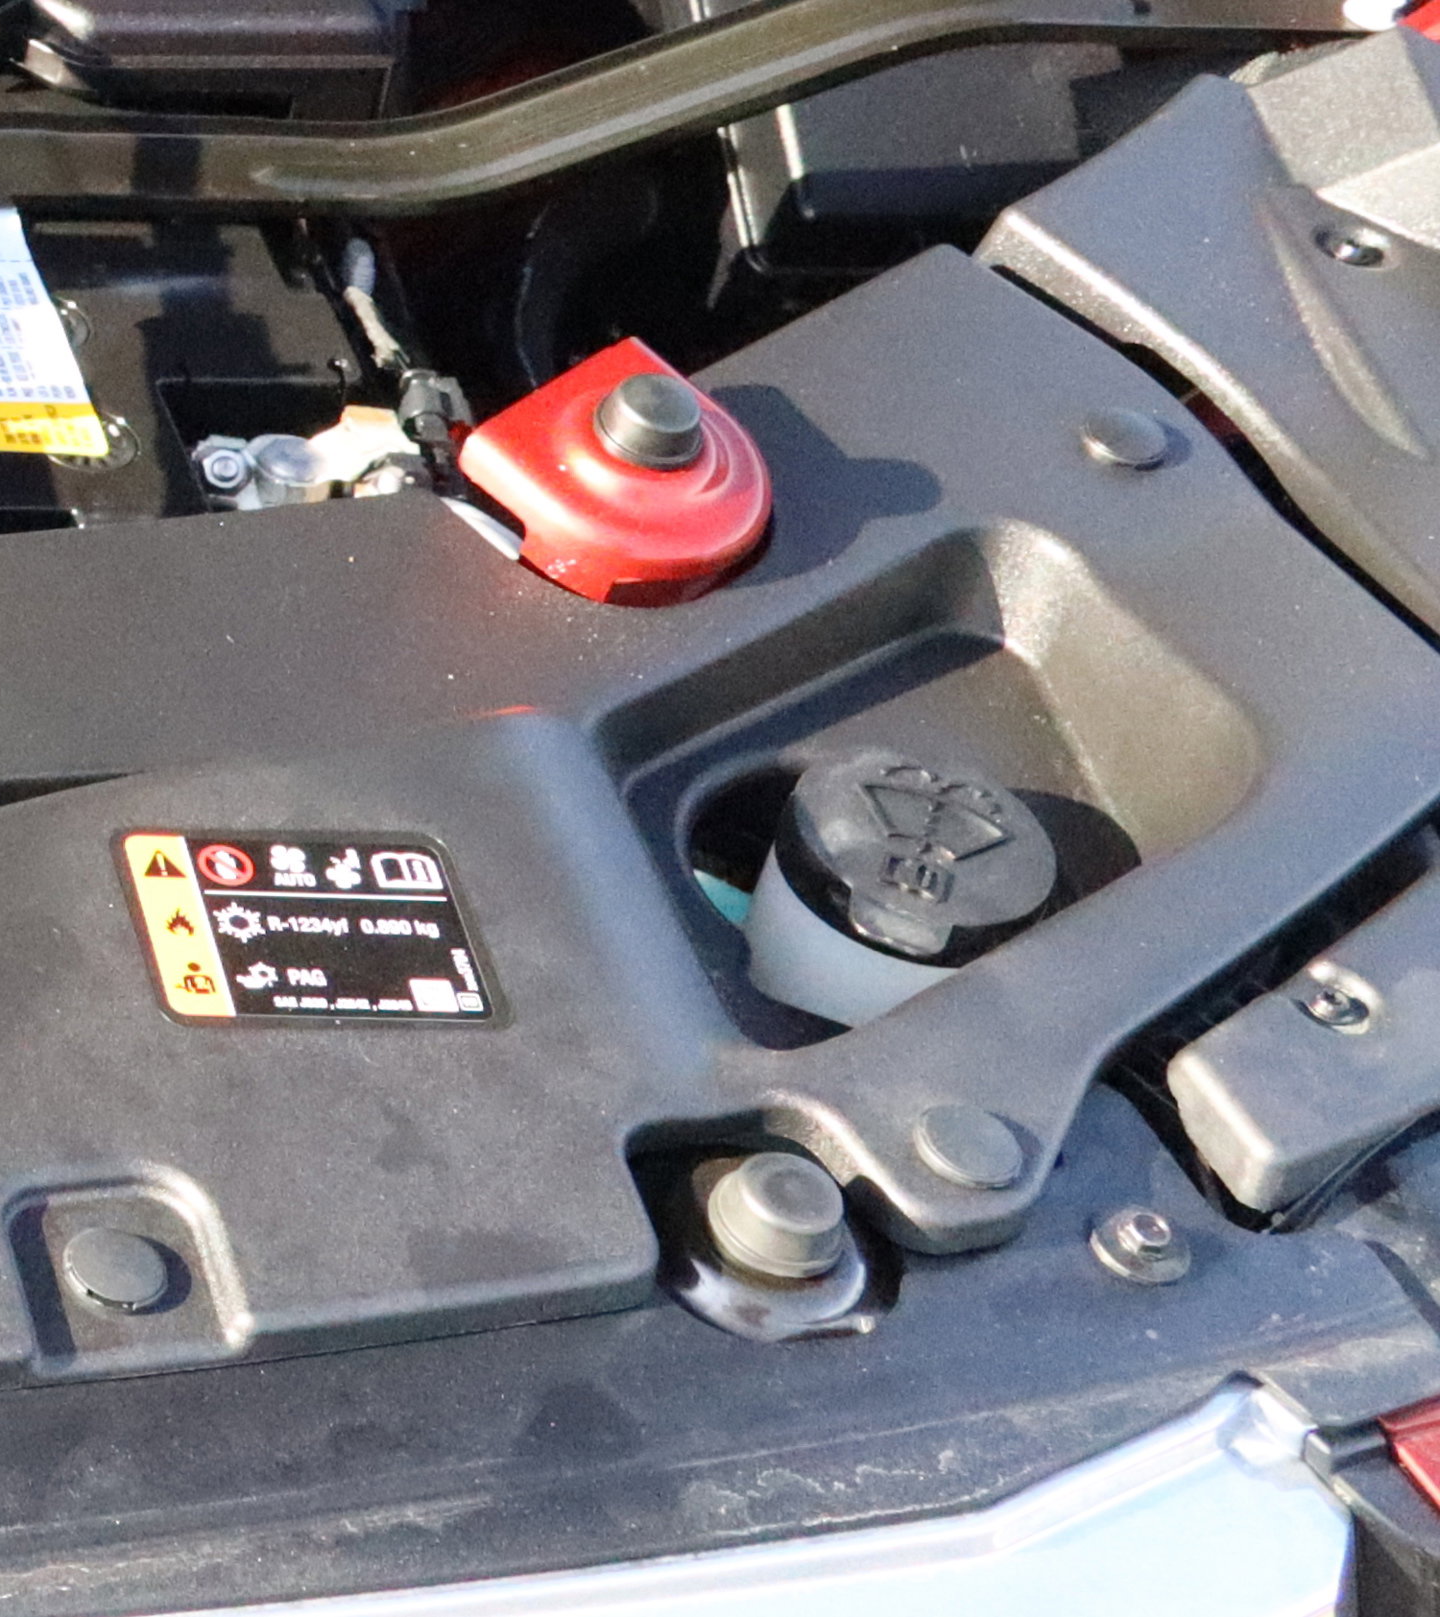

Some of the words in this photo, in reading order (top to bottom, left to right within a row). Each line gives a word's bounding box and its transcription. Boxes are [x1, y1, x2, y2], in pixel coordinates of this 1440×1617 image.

[274, 873, 317, 887] AUTO
[267, 915, 349, 937] R-1234yf
[415, 920, 441, 938] kg
[287, 968, 328, 987] PAG
